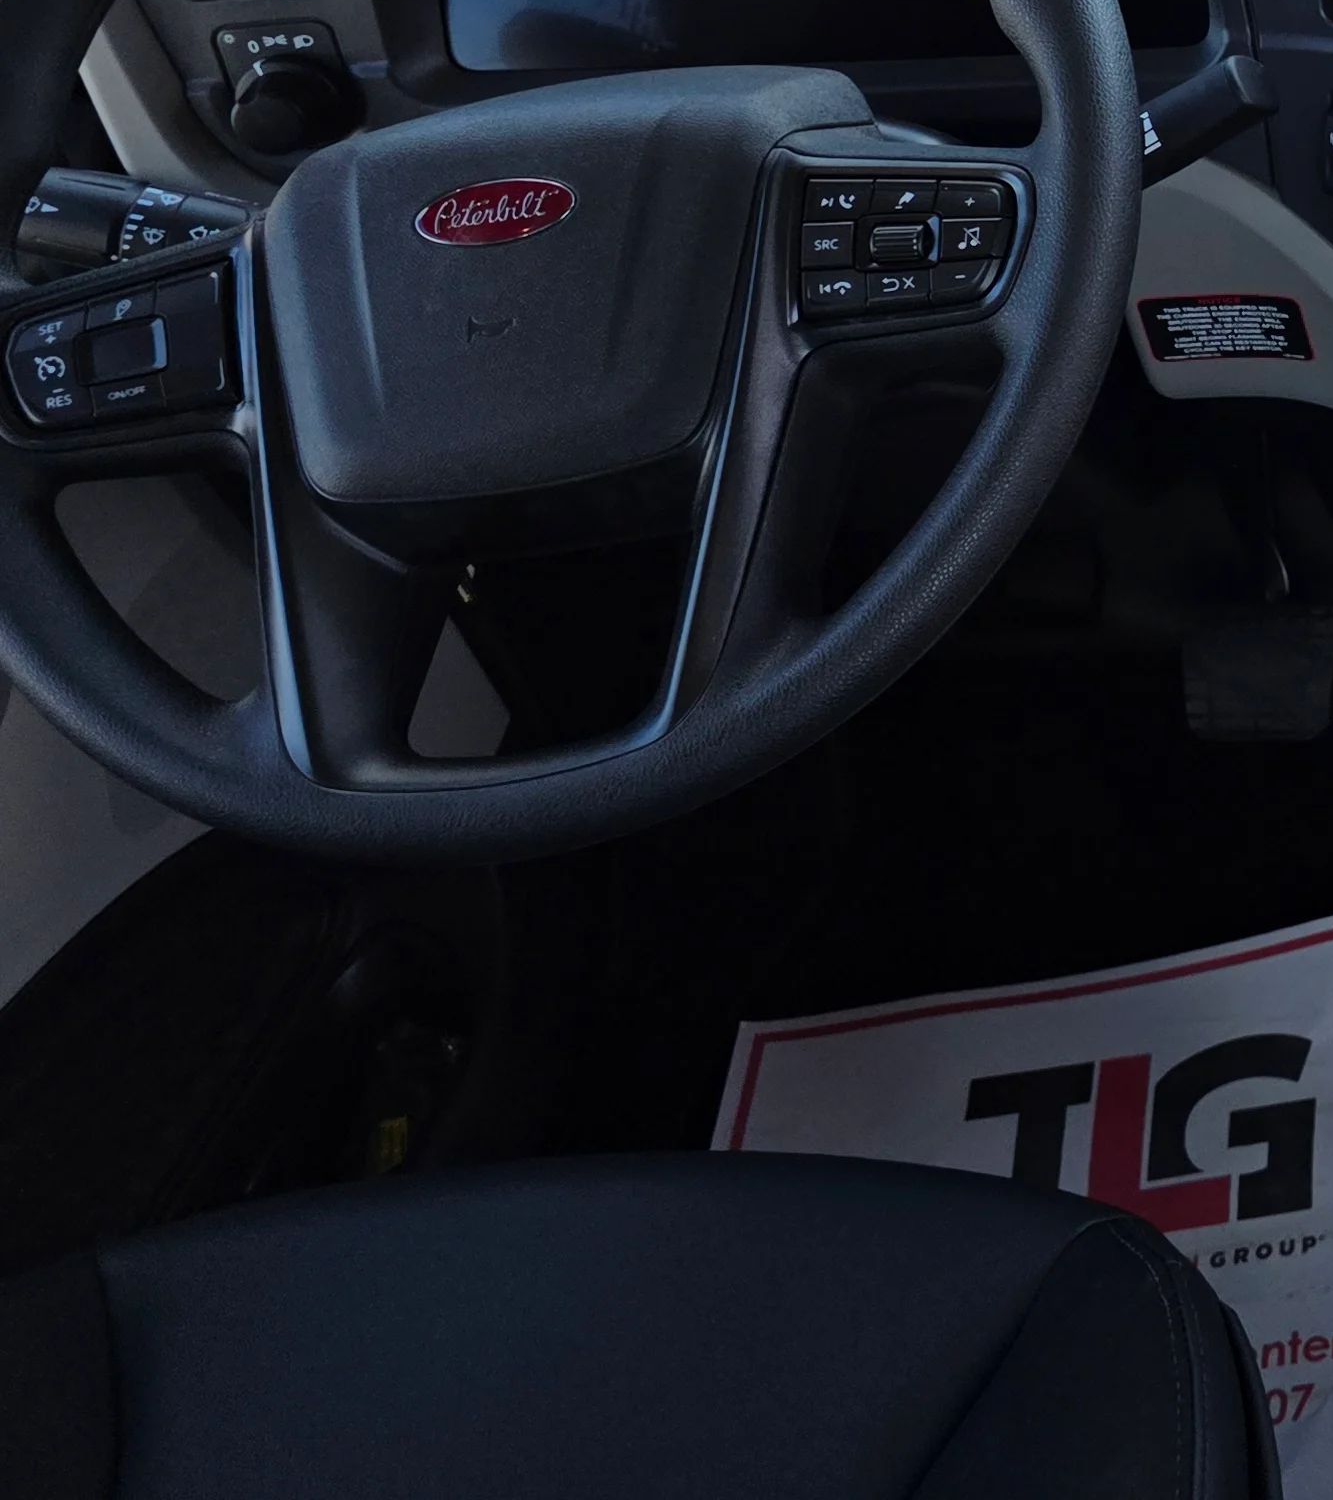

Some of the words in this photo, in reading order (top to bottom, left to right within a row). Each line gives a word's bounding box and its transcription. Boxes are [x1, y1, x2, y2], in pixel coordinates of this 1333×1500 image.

[434, 190, 559, 234] Peterbilt
[814, 238, 839, 251] SRC
[38, 321, 63, 335] SET
[107, 385, 146, 400] ON/OFF
[46, 394, 73, 409] RES
[965, 1033, 1316, 1233] TLG
[1210, 1234, 1318, 1268] GROUP
